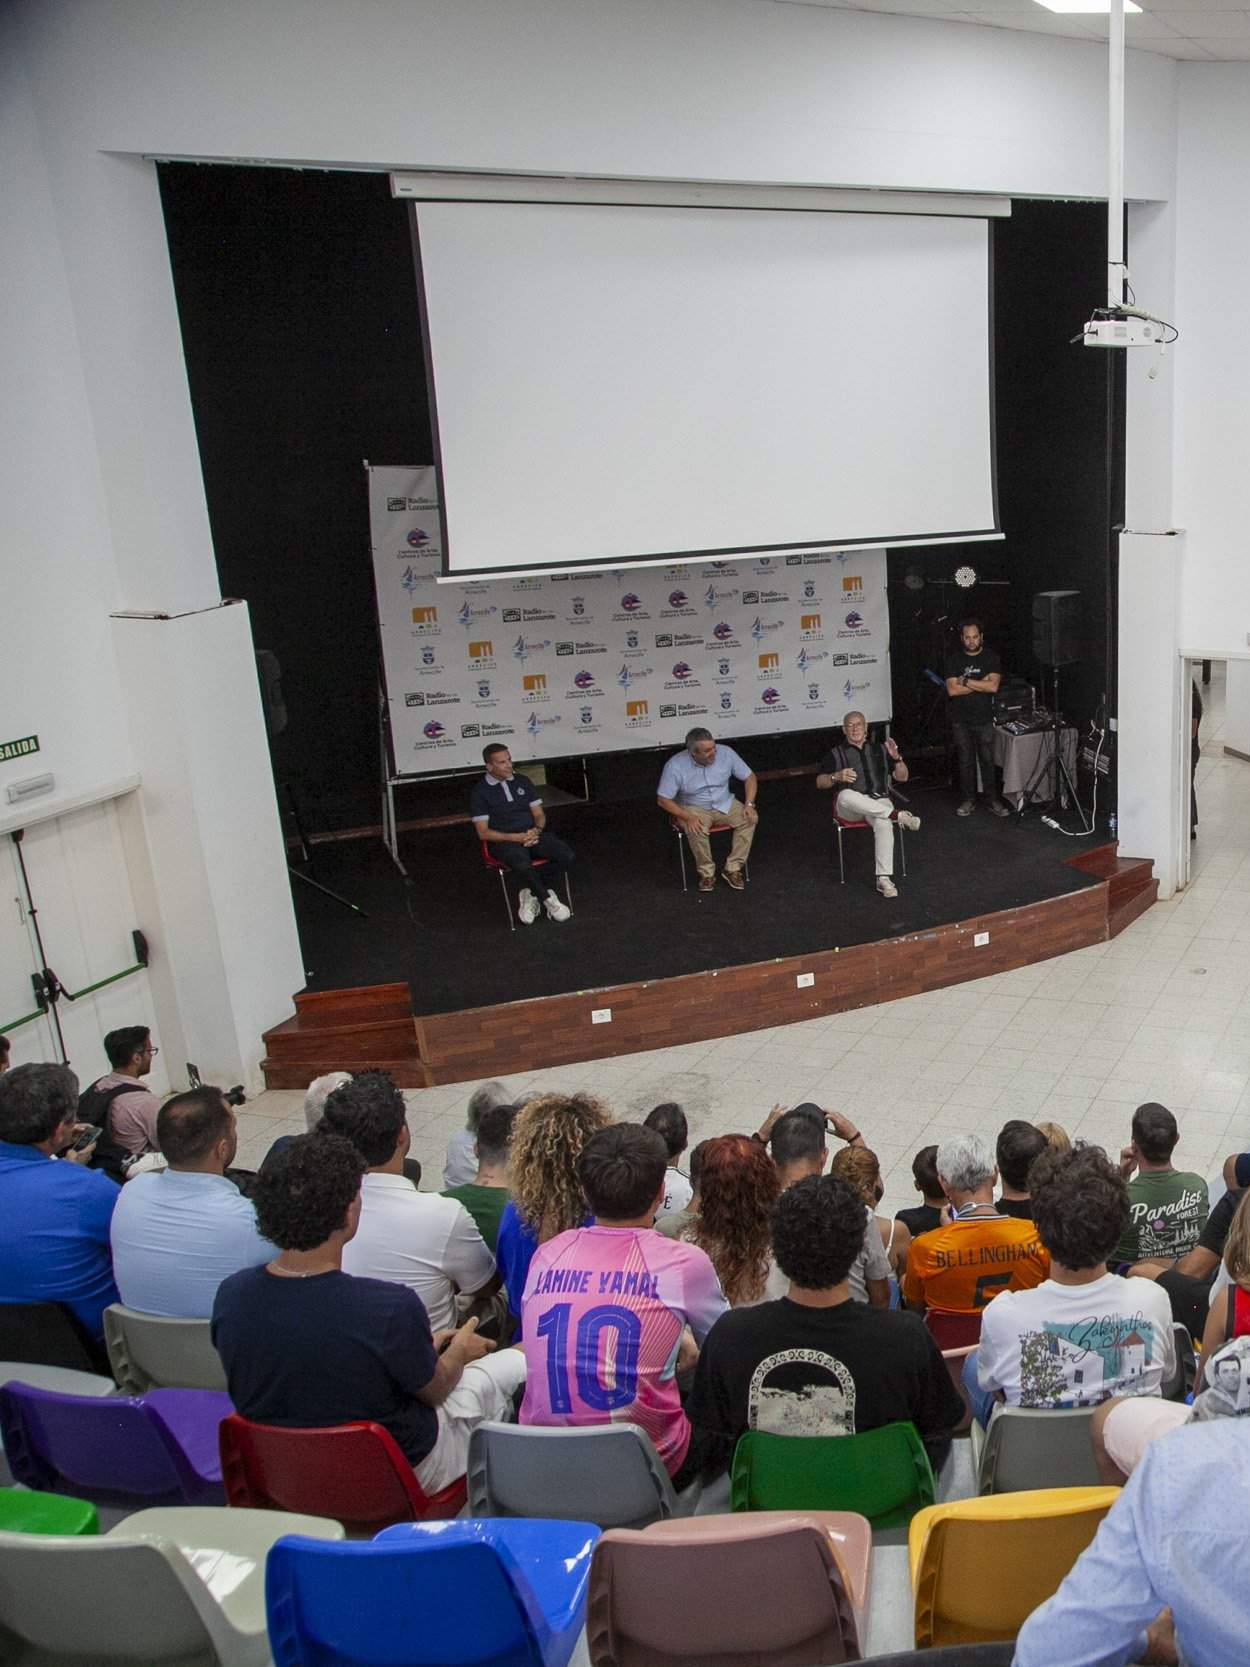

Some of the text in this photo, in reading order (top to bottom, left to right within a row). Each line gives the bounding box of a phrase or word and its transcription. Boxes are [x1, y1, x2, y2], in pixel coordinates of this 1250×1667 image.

[0, 738, 37, 760] SALIDA
[1129, 1189, 1202, 1225] Paradise
[1176, 1206, 1199, 1220] FOREST
[935, 1242, 1042, 1268] BELLINGHAM
[535, 1269, 660, 1299] LAMINE YAMAL
[536, 1302, 641, 1415] 10
